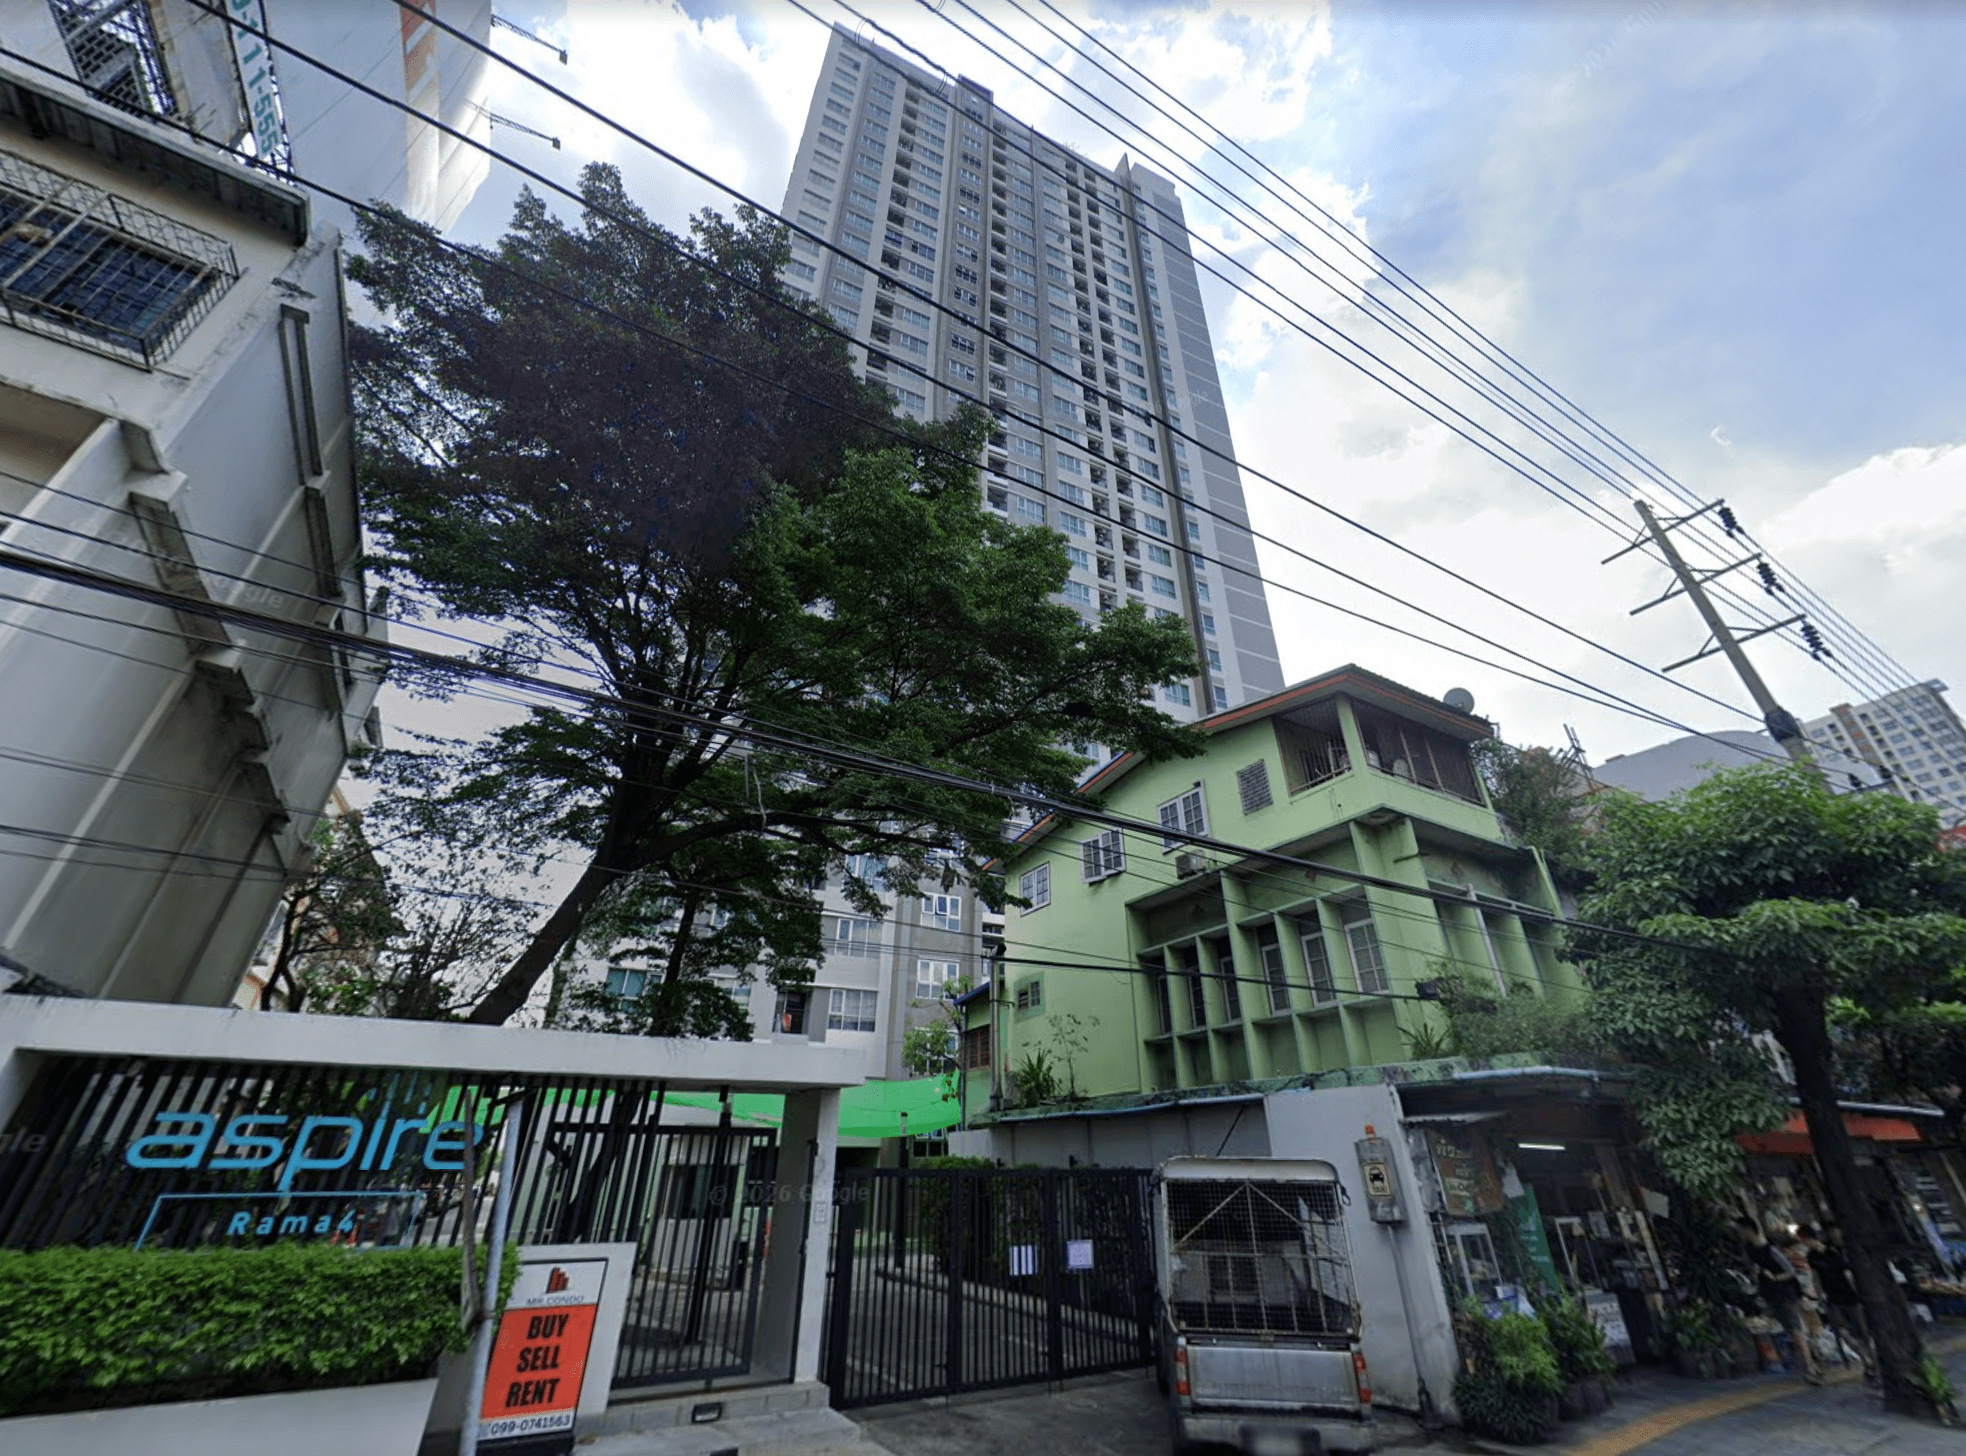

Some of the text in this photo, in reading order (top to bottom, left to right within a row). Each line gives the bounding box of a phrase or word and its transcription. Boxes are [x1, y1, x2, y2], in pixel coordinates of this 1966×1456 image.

[125, 1111, 484, 1192] aspire
[526, 1313, 570, 1340] BUY
[516, 1345, 561, 1373] SELL
[505, 1377, 561, 1408] RENT
